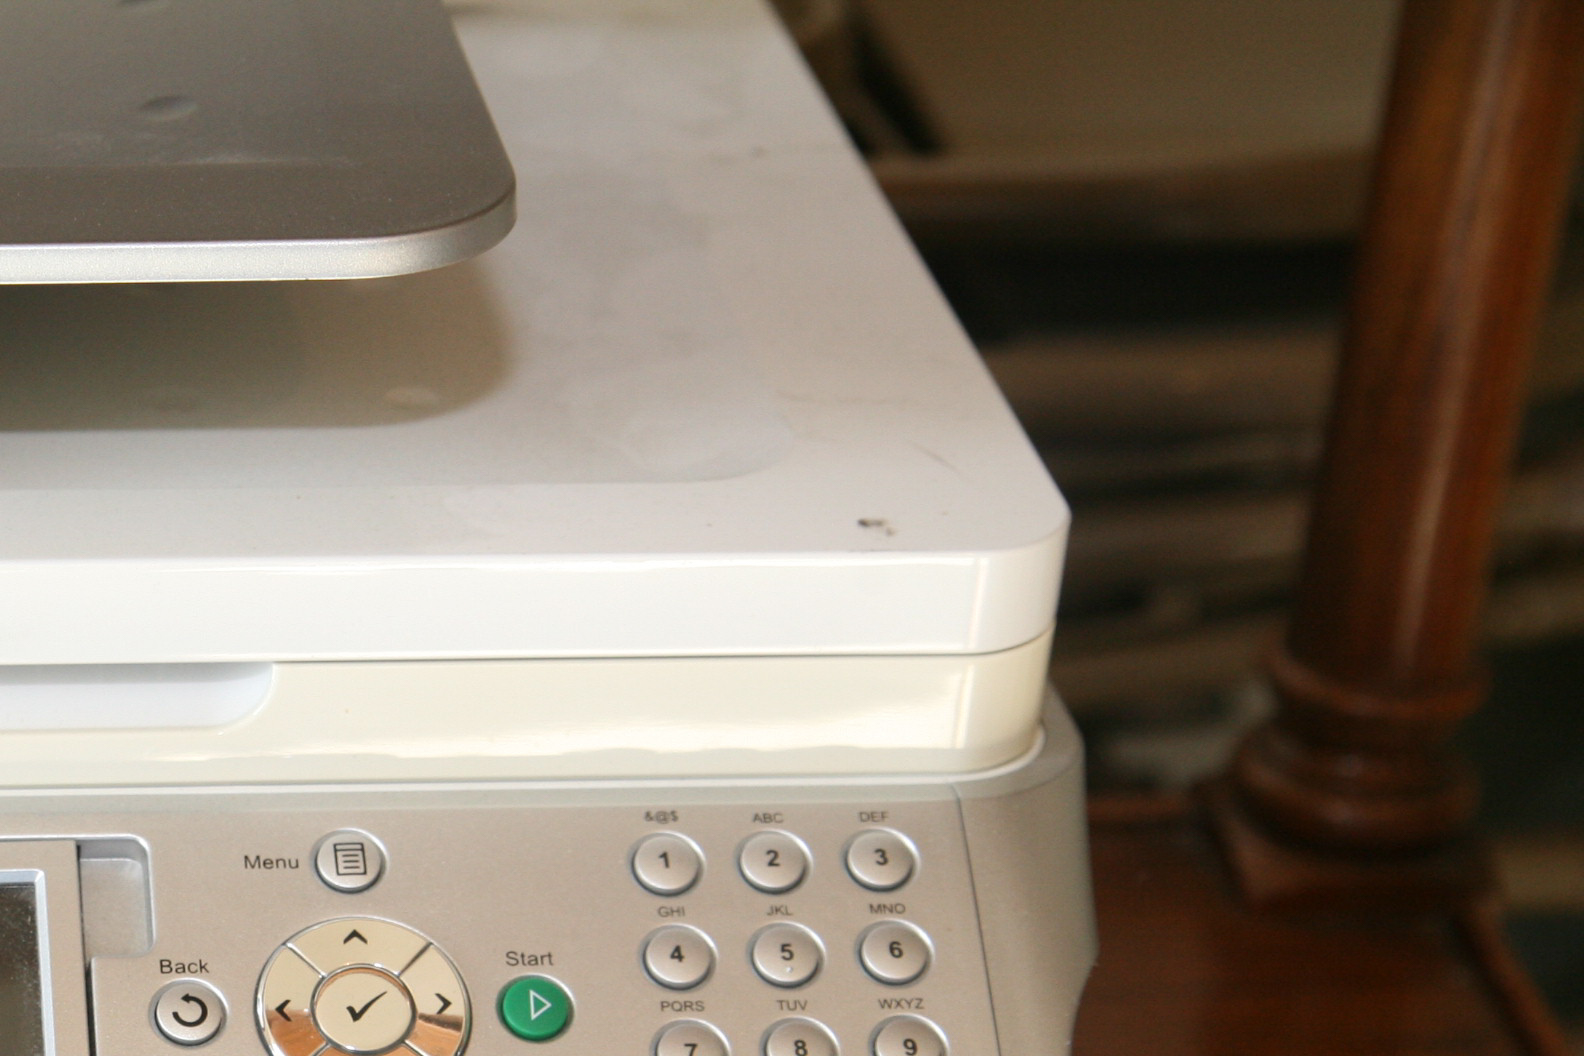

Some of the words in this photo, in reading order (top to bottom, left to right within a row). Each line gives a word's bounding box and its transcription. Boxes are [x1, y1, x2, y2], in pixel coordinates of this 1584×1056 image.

[751, 812, 785, 825] ABC
[857, 810, 890, 824] DEF
[243, 854, 300, 870] Menu
[658, 851, 670, 869] 1
[765, 849, 781, 868] 2
[873, 847, 889, 867] 3
[656, 905, 686, 918] GHI
[766, 904, 794, 917] JKL
[868, 902, 907, 915] MNO
[669, 944, 685, 963] 4
[780, 942, 795, 962] 5
[888, 940, 904, 959] 6
[159, 958, 210, 975] Back
[505, 950, 554, 967] Start
[659, 999, 706, 1013] PQRS
[775, 999, 809, 1012] TUV
[877, 997, 925, 1010] WXYZ
[902, 1037, 918, 1056] 9
